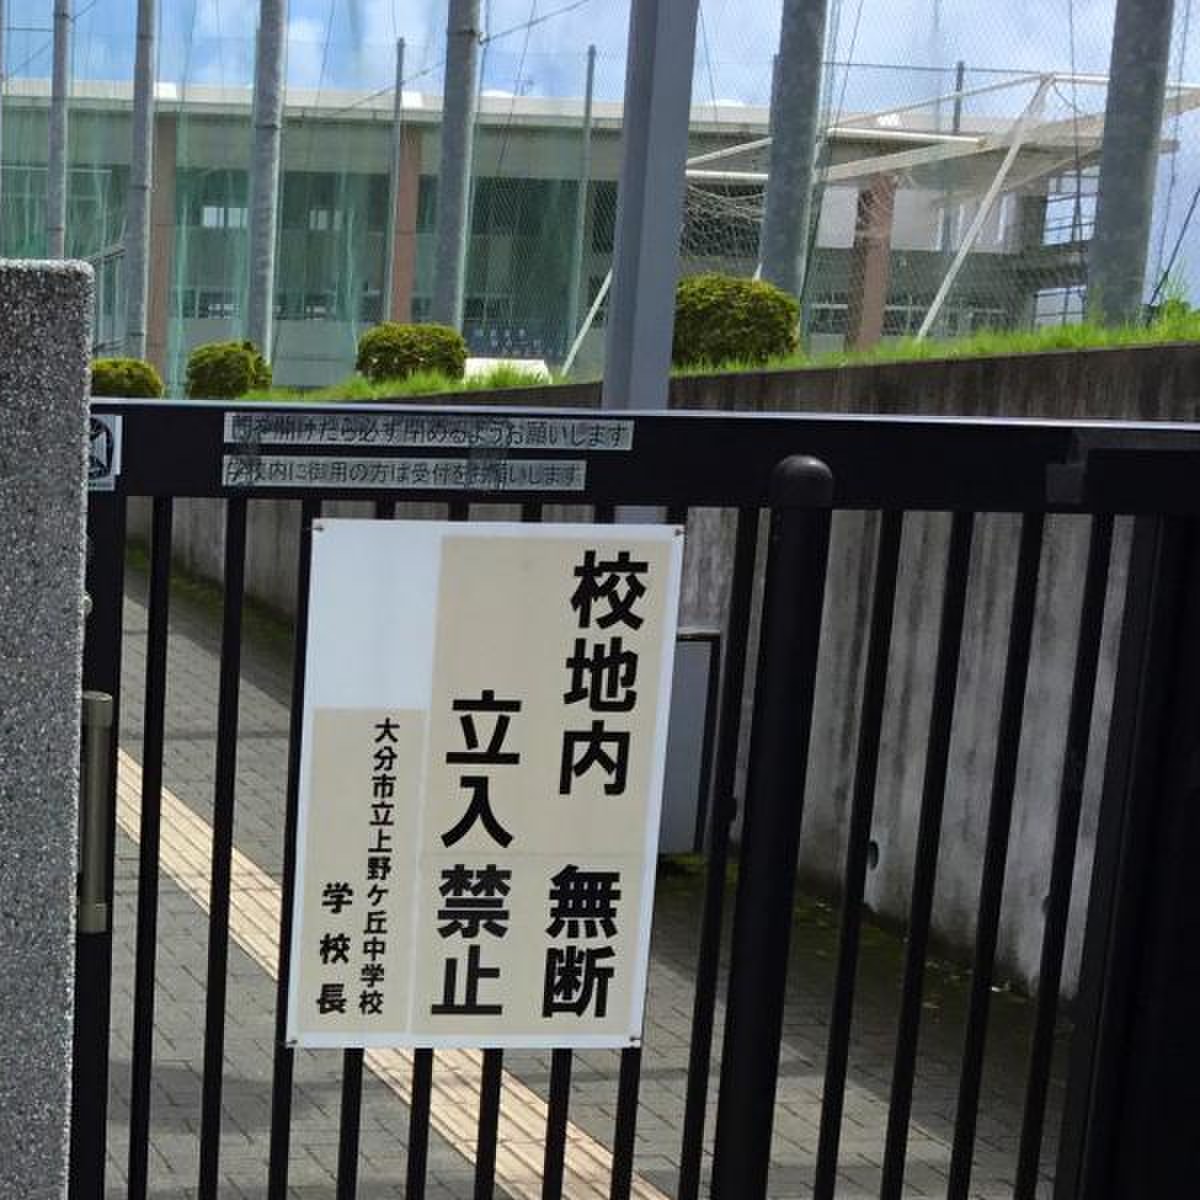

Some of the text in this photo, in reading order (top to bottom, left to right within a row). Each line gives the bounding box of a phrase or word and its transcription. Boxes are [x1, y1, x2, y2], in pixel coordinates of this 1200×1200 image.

[431, 689, 522, 1017] 立入禁止
[541, 550, 648, 1018] 校地内 無断
